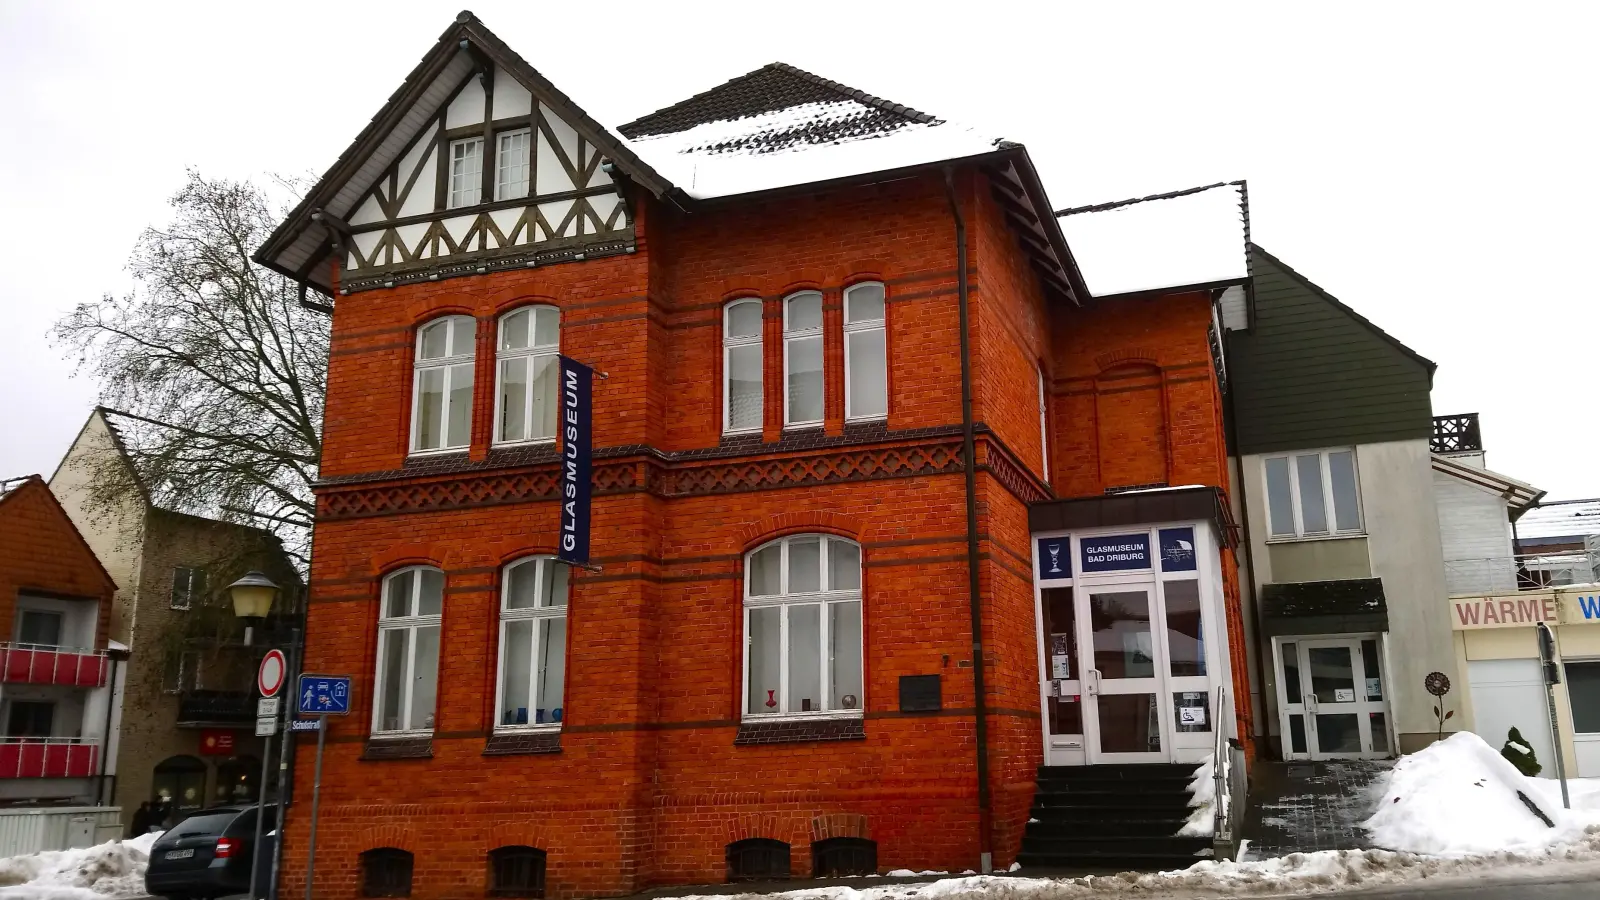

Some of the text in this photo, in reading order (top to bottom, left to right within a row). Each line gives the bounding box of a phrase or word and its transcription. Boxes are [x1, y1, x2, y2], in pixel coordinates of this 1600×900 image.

[563, 369, 578, 552] GLASMUSEUM
[1087, 543, 1144, 553] GLASMUSEUM
[1107, 553, 1144, 561] DRIBURG
[1456, 597, 1557, 626] WÄRME
[1578, 595, 1600, 620] W
[292, 720, 320, 730] Schulstraß
